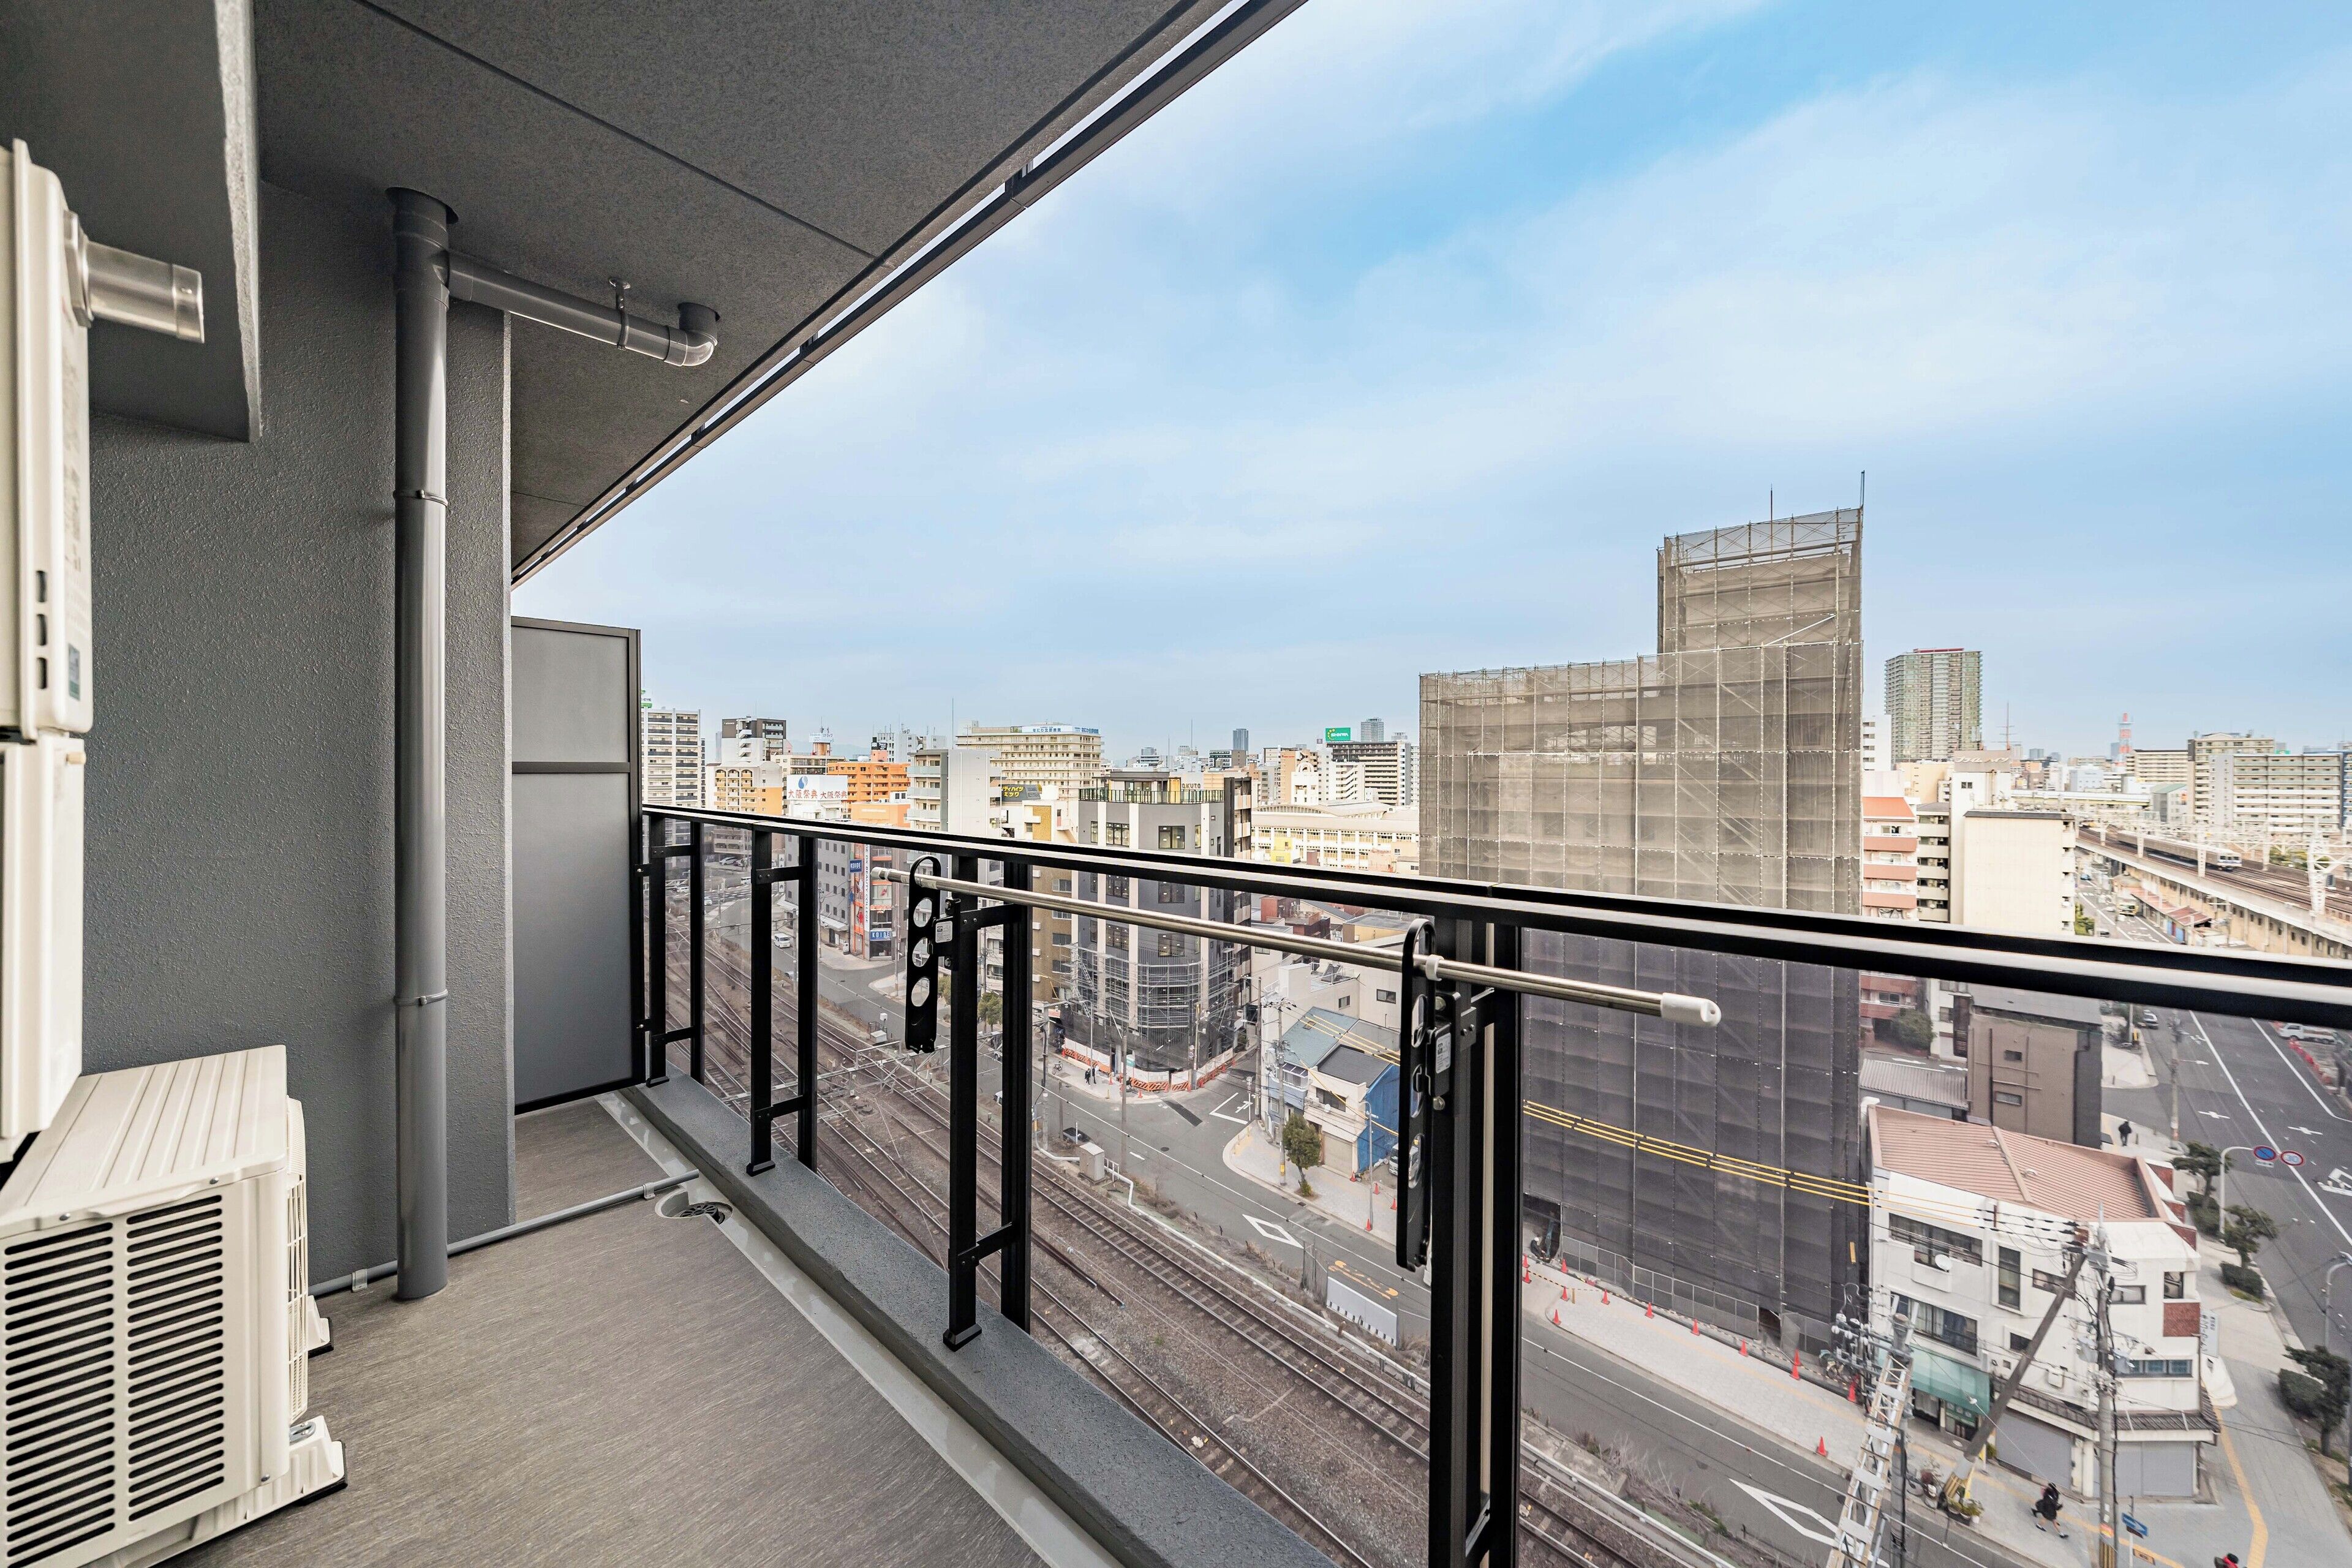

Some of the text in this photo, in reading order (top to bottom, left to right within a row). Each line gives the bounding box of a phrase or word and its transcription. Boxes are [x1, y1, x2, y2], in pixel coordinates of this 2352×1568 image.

[788, 789, 818, 799] 大阪祭典
[820, 790, 847, 799] 大阪祭典
